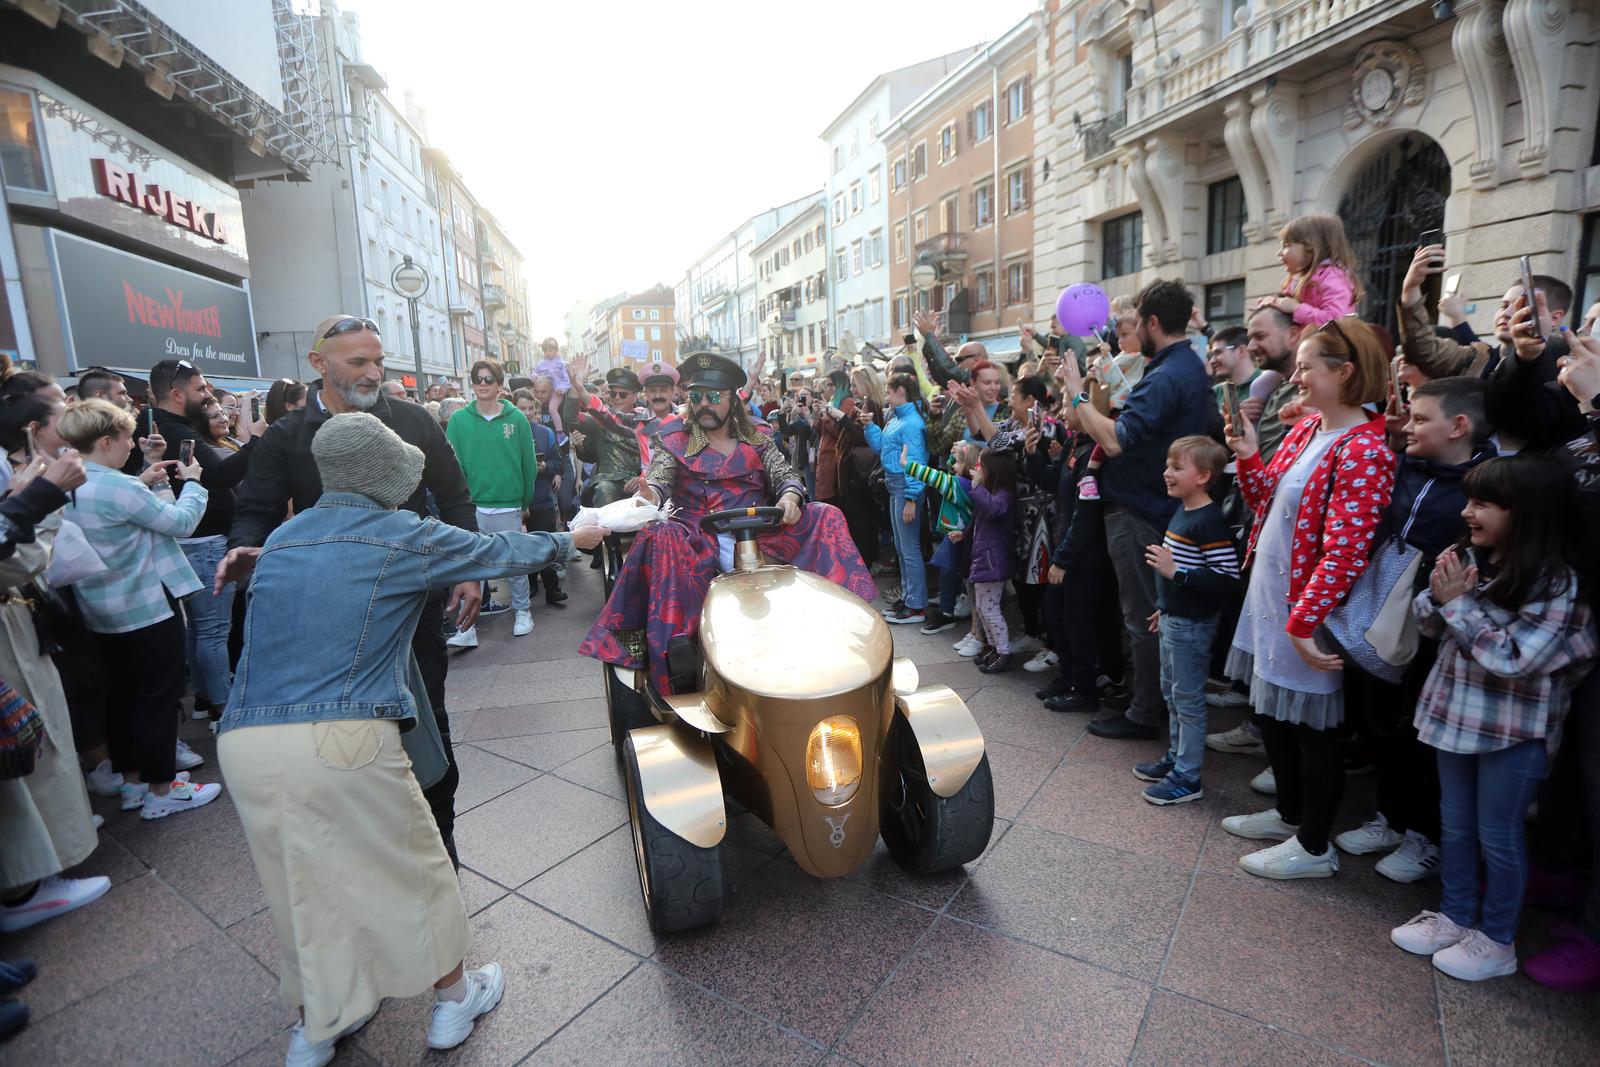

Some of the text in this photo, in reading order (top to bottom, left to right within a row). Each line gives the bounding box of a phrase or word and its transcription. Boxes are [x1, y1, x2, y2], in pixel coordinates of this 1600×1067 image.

[91, 158, 226, 244] RIJEKA
[165, 336, 190, 357] Dress
[190, 341, 203, 362] for
[205, 345, 217, 360] the
